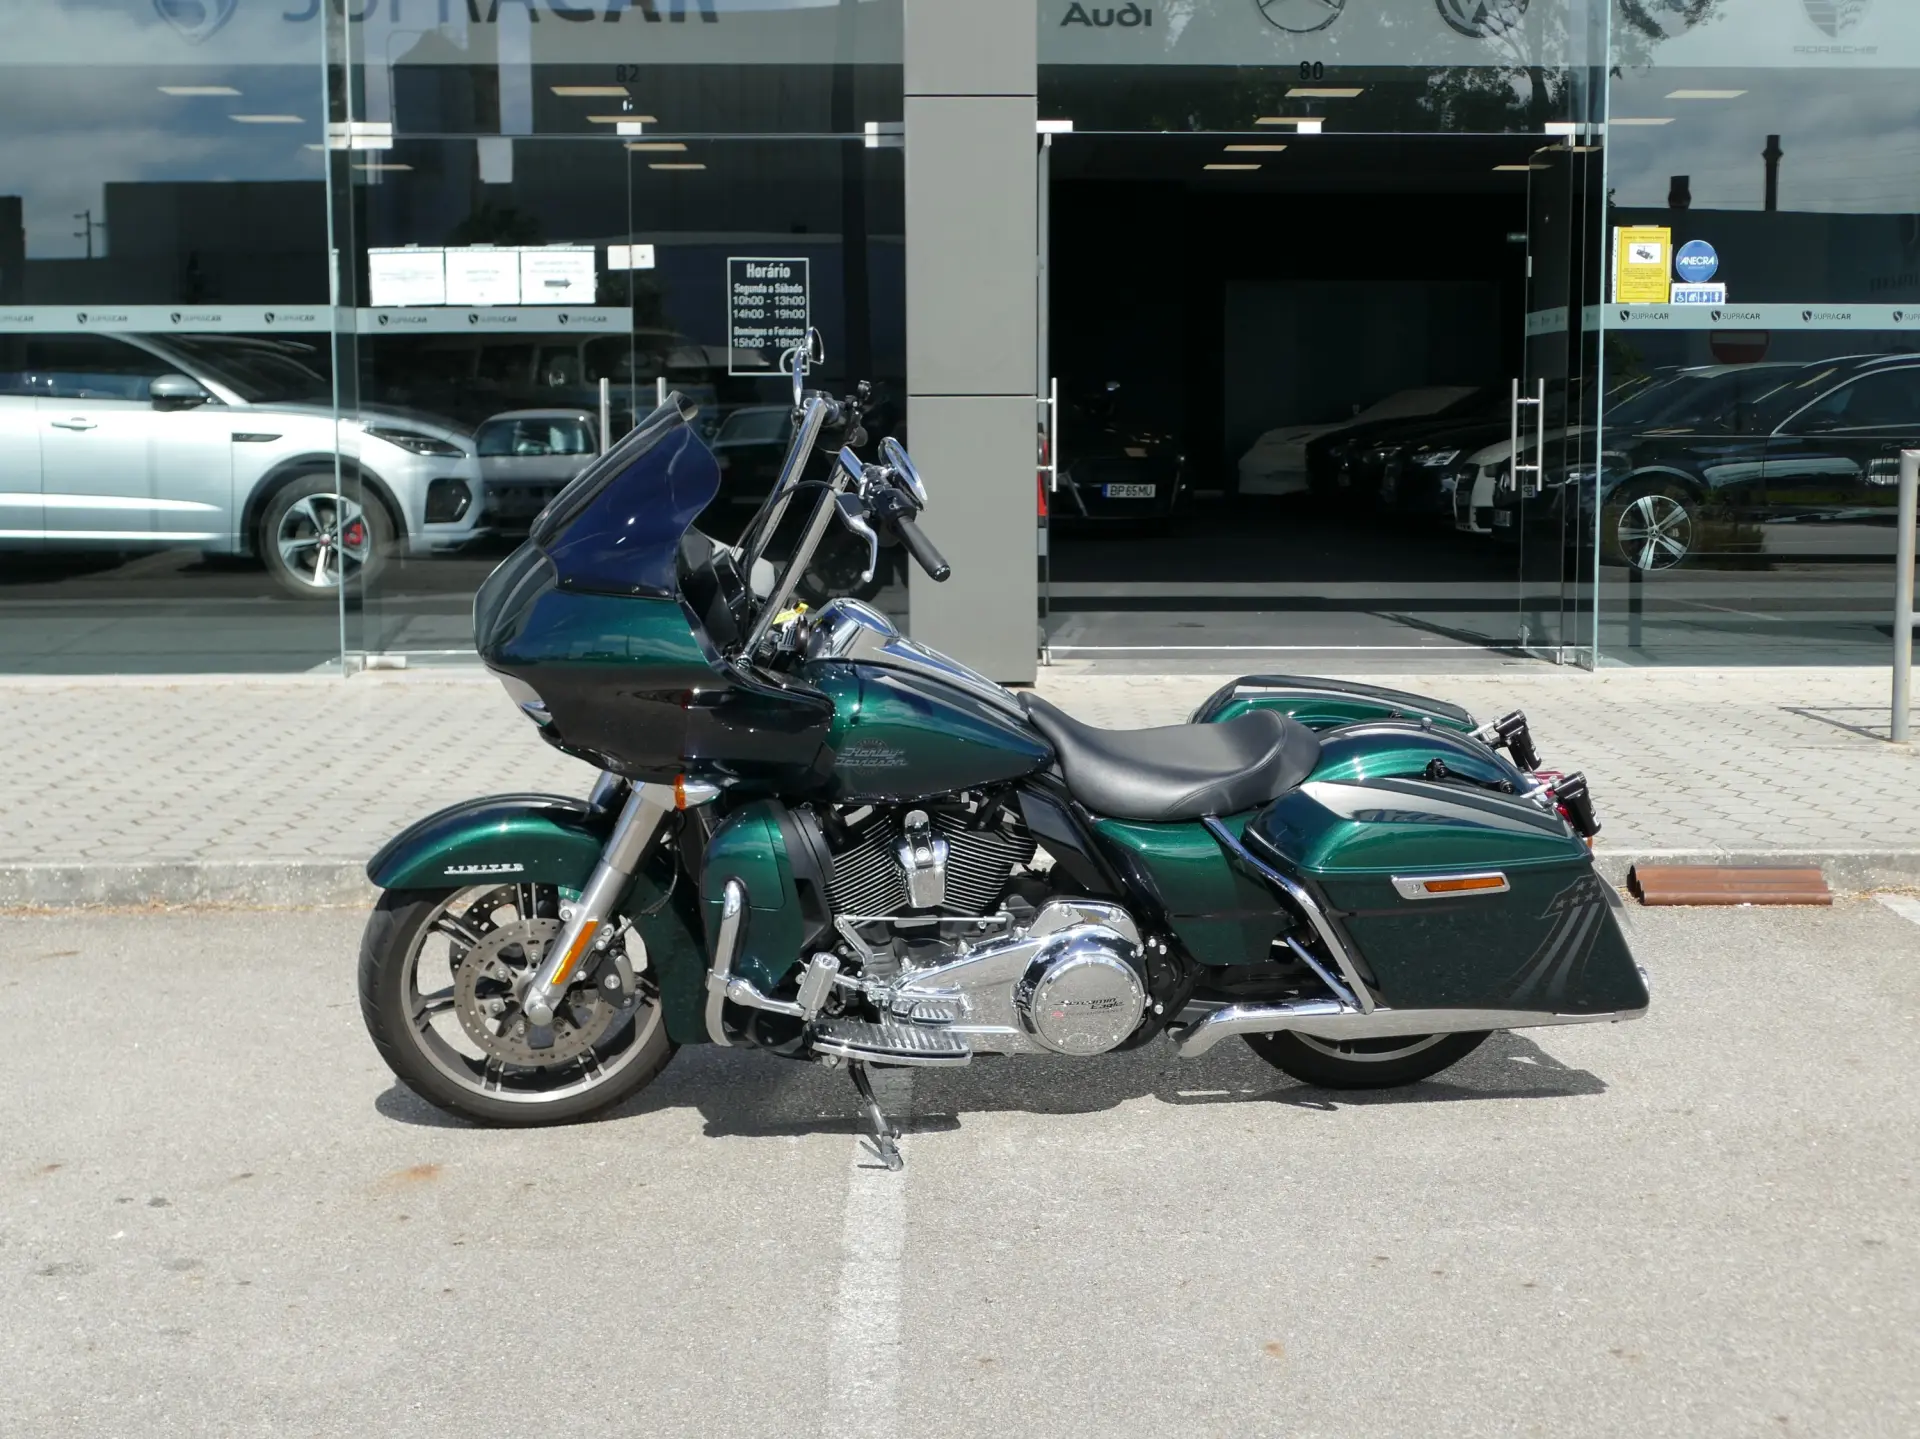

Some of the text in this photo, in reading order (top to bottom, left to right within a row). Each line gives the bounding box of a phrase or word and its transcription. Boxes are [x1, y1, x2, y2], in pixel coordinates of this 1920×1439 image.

[1060, 2, 1152, 26] Audi
[1793, 46, 1878, 55] PORSCHE
[615, 64, 640, 83] 82
[1299, 61, 1324, 80] 80
[1679, 256, 1715, 265] ANECRA
[746, 262, 791, 278] Horário
[734, 283, 767, 295] Segunda
[774, 282, 804, 293] Sábado
[733, 295, 765, 306] 10h00
[774, 295, 806, 306] 13h00
[733, 309, 765, 319] 14h00
[774, 309, 806, 319] 19h00
[1631, 312, 1669, 320] SUPRACAR
[1722, 312, 1760, 320] SUPRACAR
[733, 326, 768, 337] Domingos
[733, 338, 765, 348] 15h00
[444, 863, 524, 875] LIMITED
